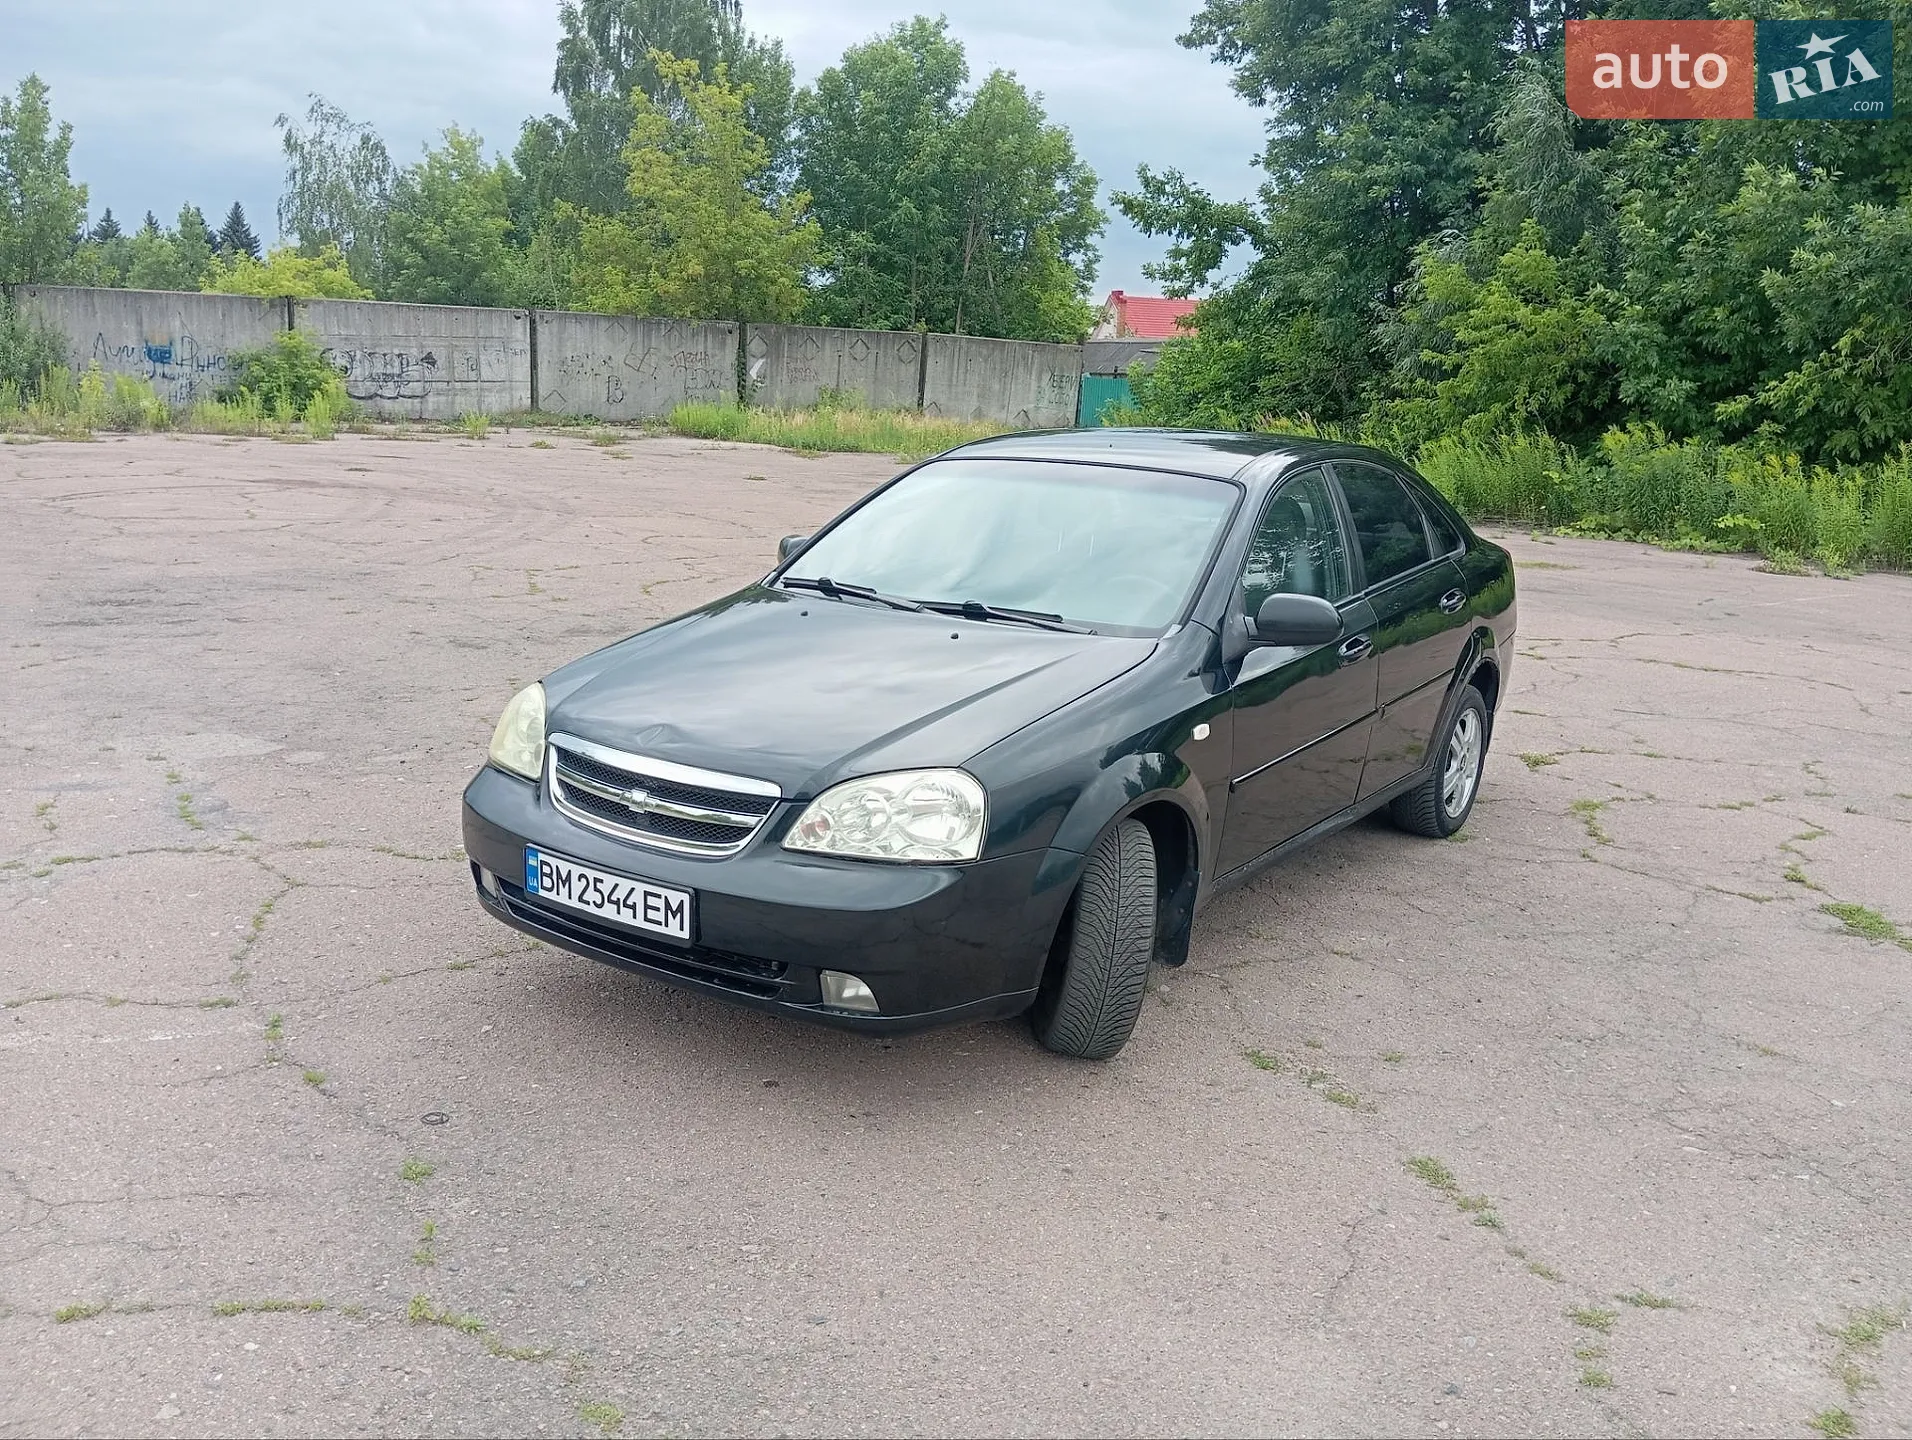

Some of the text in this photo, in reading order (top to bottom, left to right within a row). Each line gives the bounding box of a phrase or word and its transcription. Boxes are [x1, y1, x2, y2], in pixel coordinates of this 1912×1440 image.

[528, 875, 538, 889] UA
[539, 858, 685, 933] BM 2544 EM
